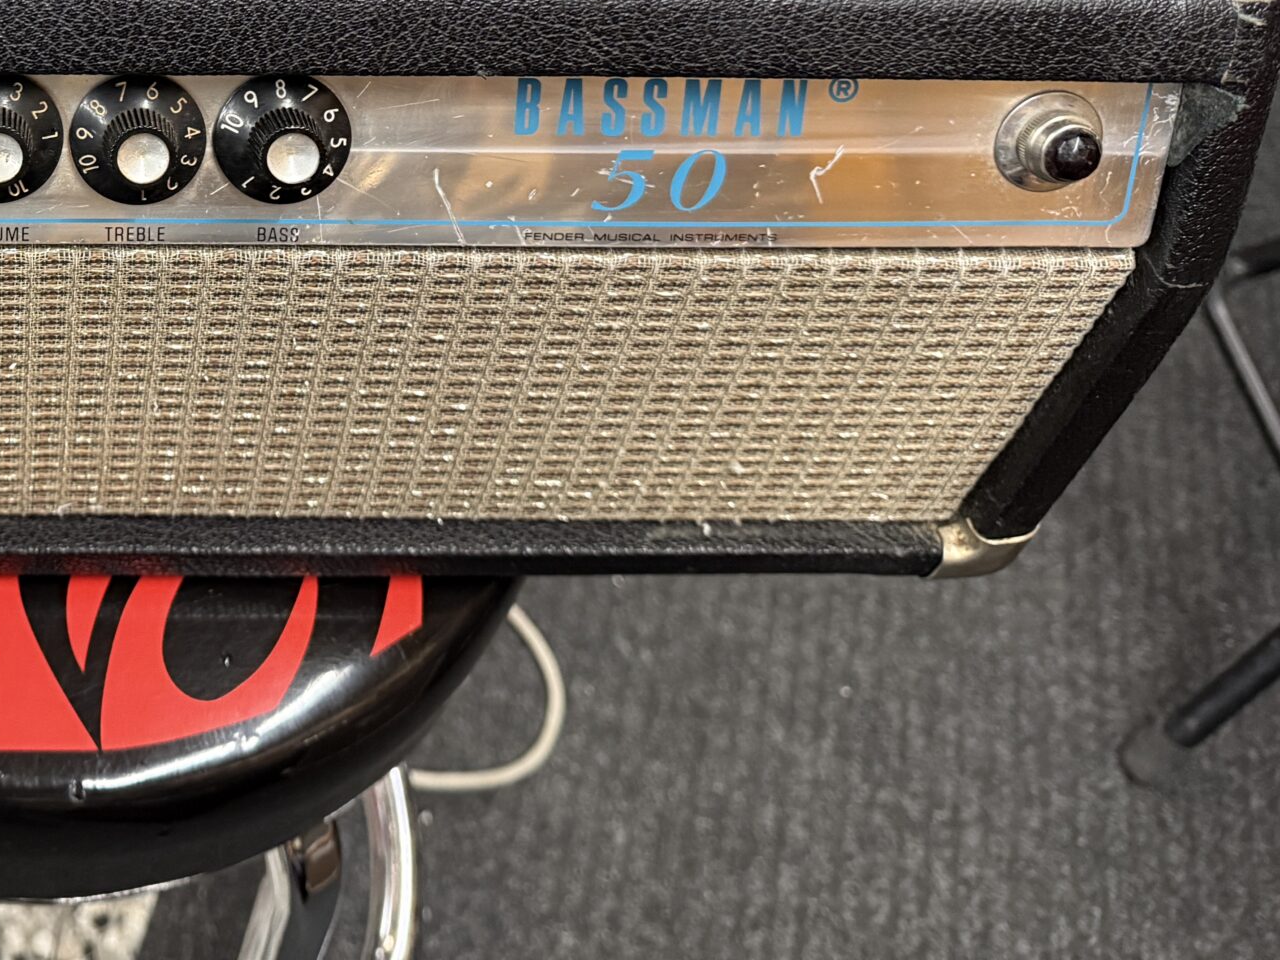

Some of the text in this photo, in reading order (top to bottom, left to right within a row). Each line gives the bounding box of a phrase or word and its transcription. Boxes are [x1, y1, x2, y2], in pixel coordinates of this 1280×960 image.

[10, 82, 23, 101] 3
[115, 81, 127, 102] 7
[146, 82, 159, 100] 6
[275, 79, 286, 99] 8
[302, 84, 318, 101] 7
[90, 99, 106, 115] 8
[170, 97, 188, 114] 5
[244, 91, 258, 108] 9
[514, 78, 808, 137] BASSMAN
[32, 101, 48, 119] 2
[184, 126, 201, 139] 4
[220, 114, 244, 134] 10
[42, 131, 58, 139] 1
[331, 138, 347, 148] 5
[78, 154, 99, 174] 10
[181, 154, 197, 166] 3
[591, 149, 727, 211] 50
[269, 185, 281, 200] 2
[105, 227, 166, 242] TREBLE
[257, 227, 300, 243] BASS
[524, 231, 778, 243] FENDER MUSICAL INSTRUMENTS
